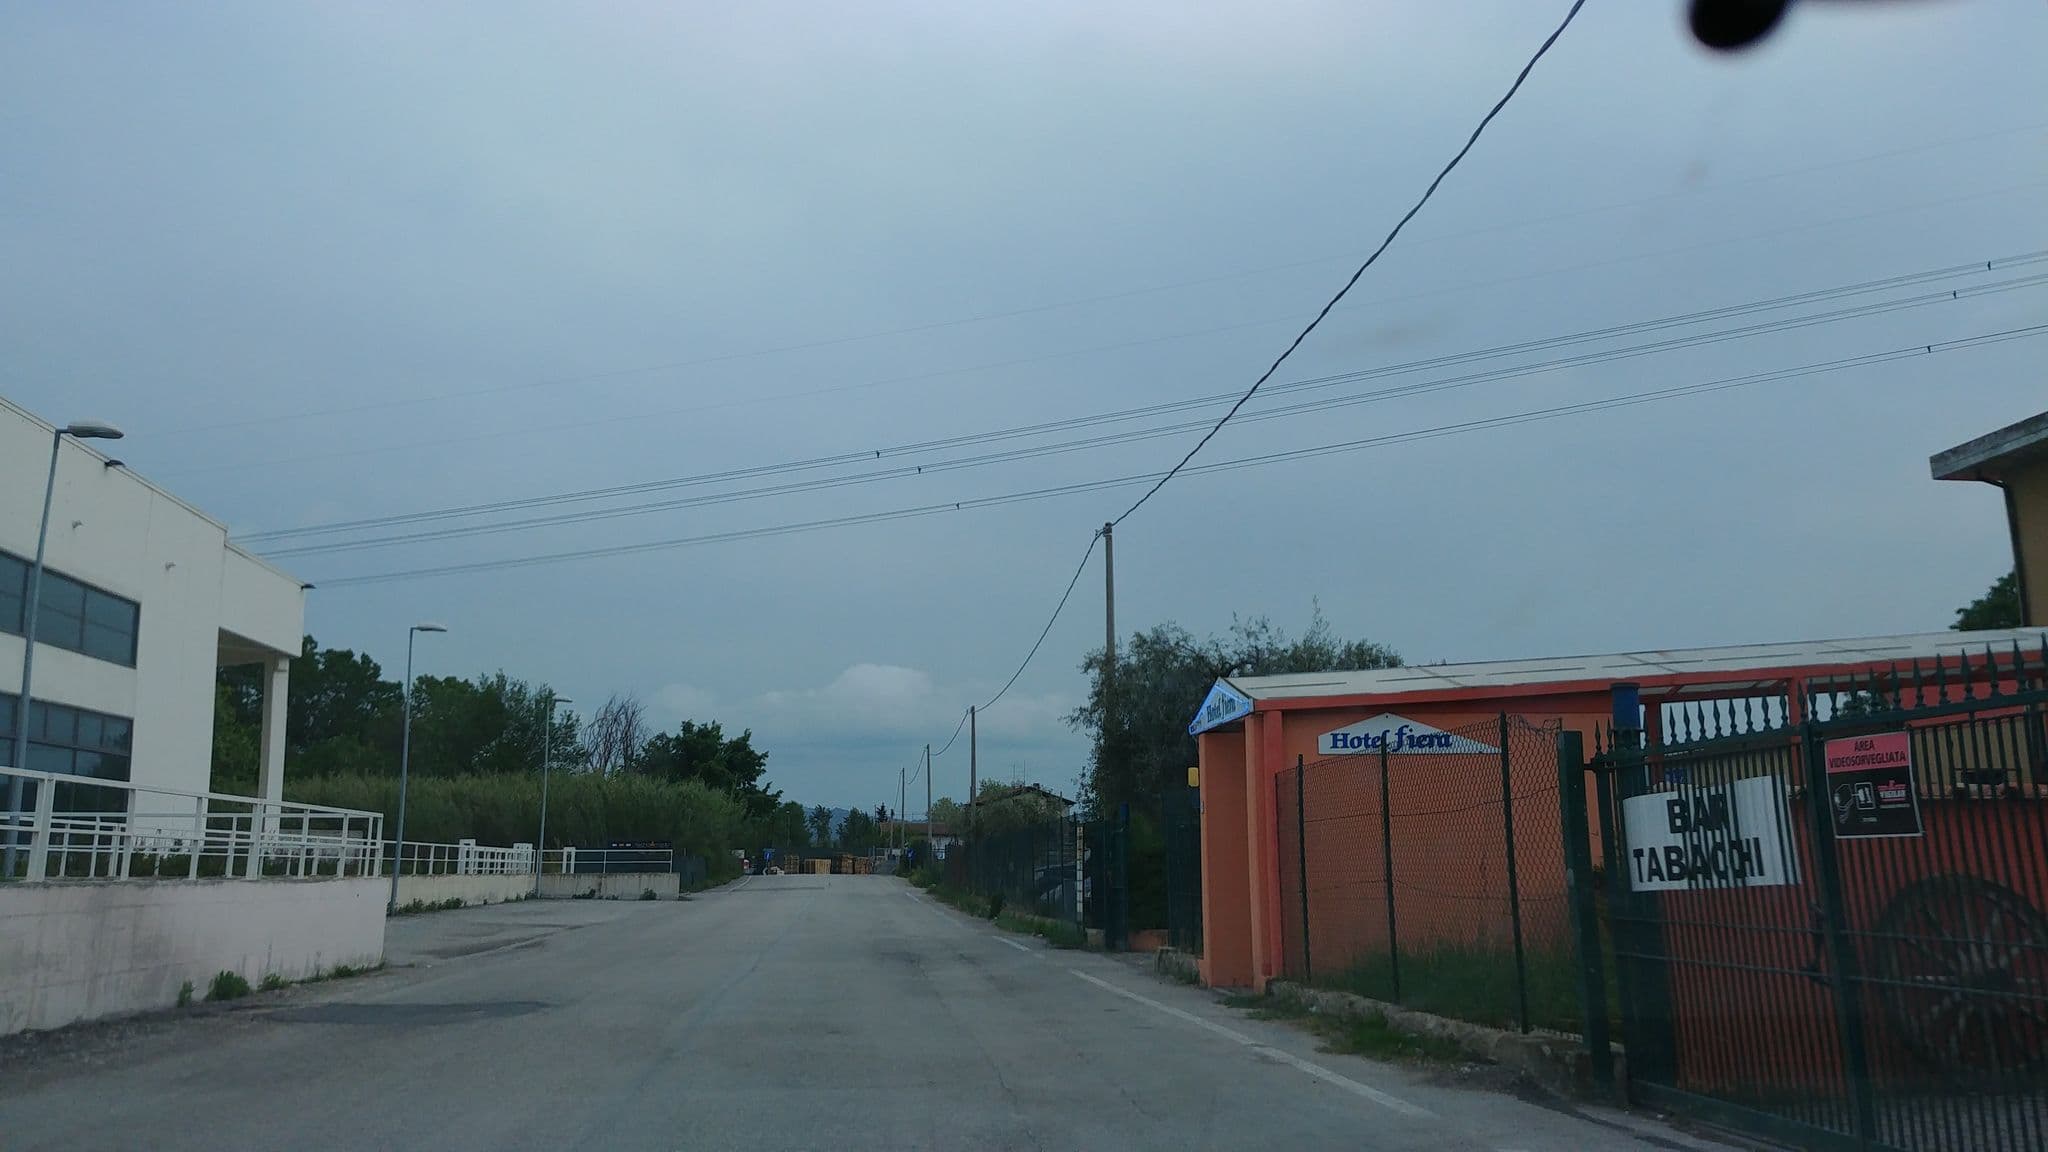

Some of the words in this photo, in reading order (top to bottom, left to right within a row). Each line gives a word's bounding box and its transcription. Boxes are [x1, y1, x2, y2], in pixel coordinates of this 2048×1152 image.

[1330, 729, 1390, 749] Hotel
[1391, 724, 1453, 752] fiera
[1854, 739, 1875, 752] AREA
[1828, 750, 1907, 769] VIDEOSORVEGLIATA
[1632, 837, 1765, 883] TABACCHI
